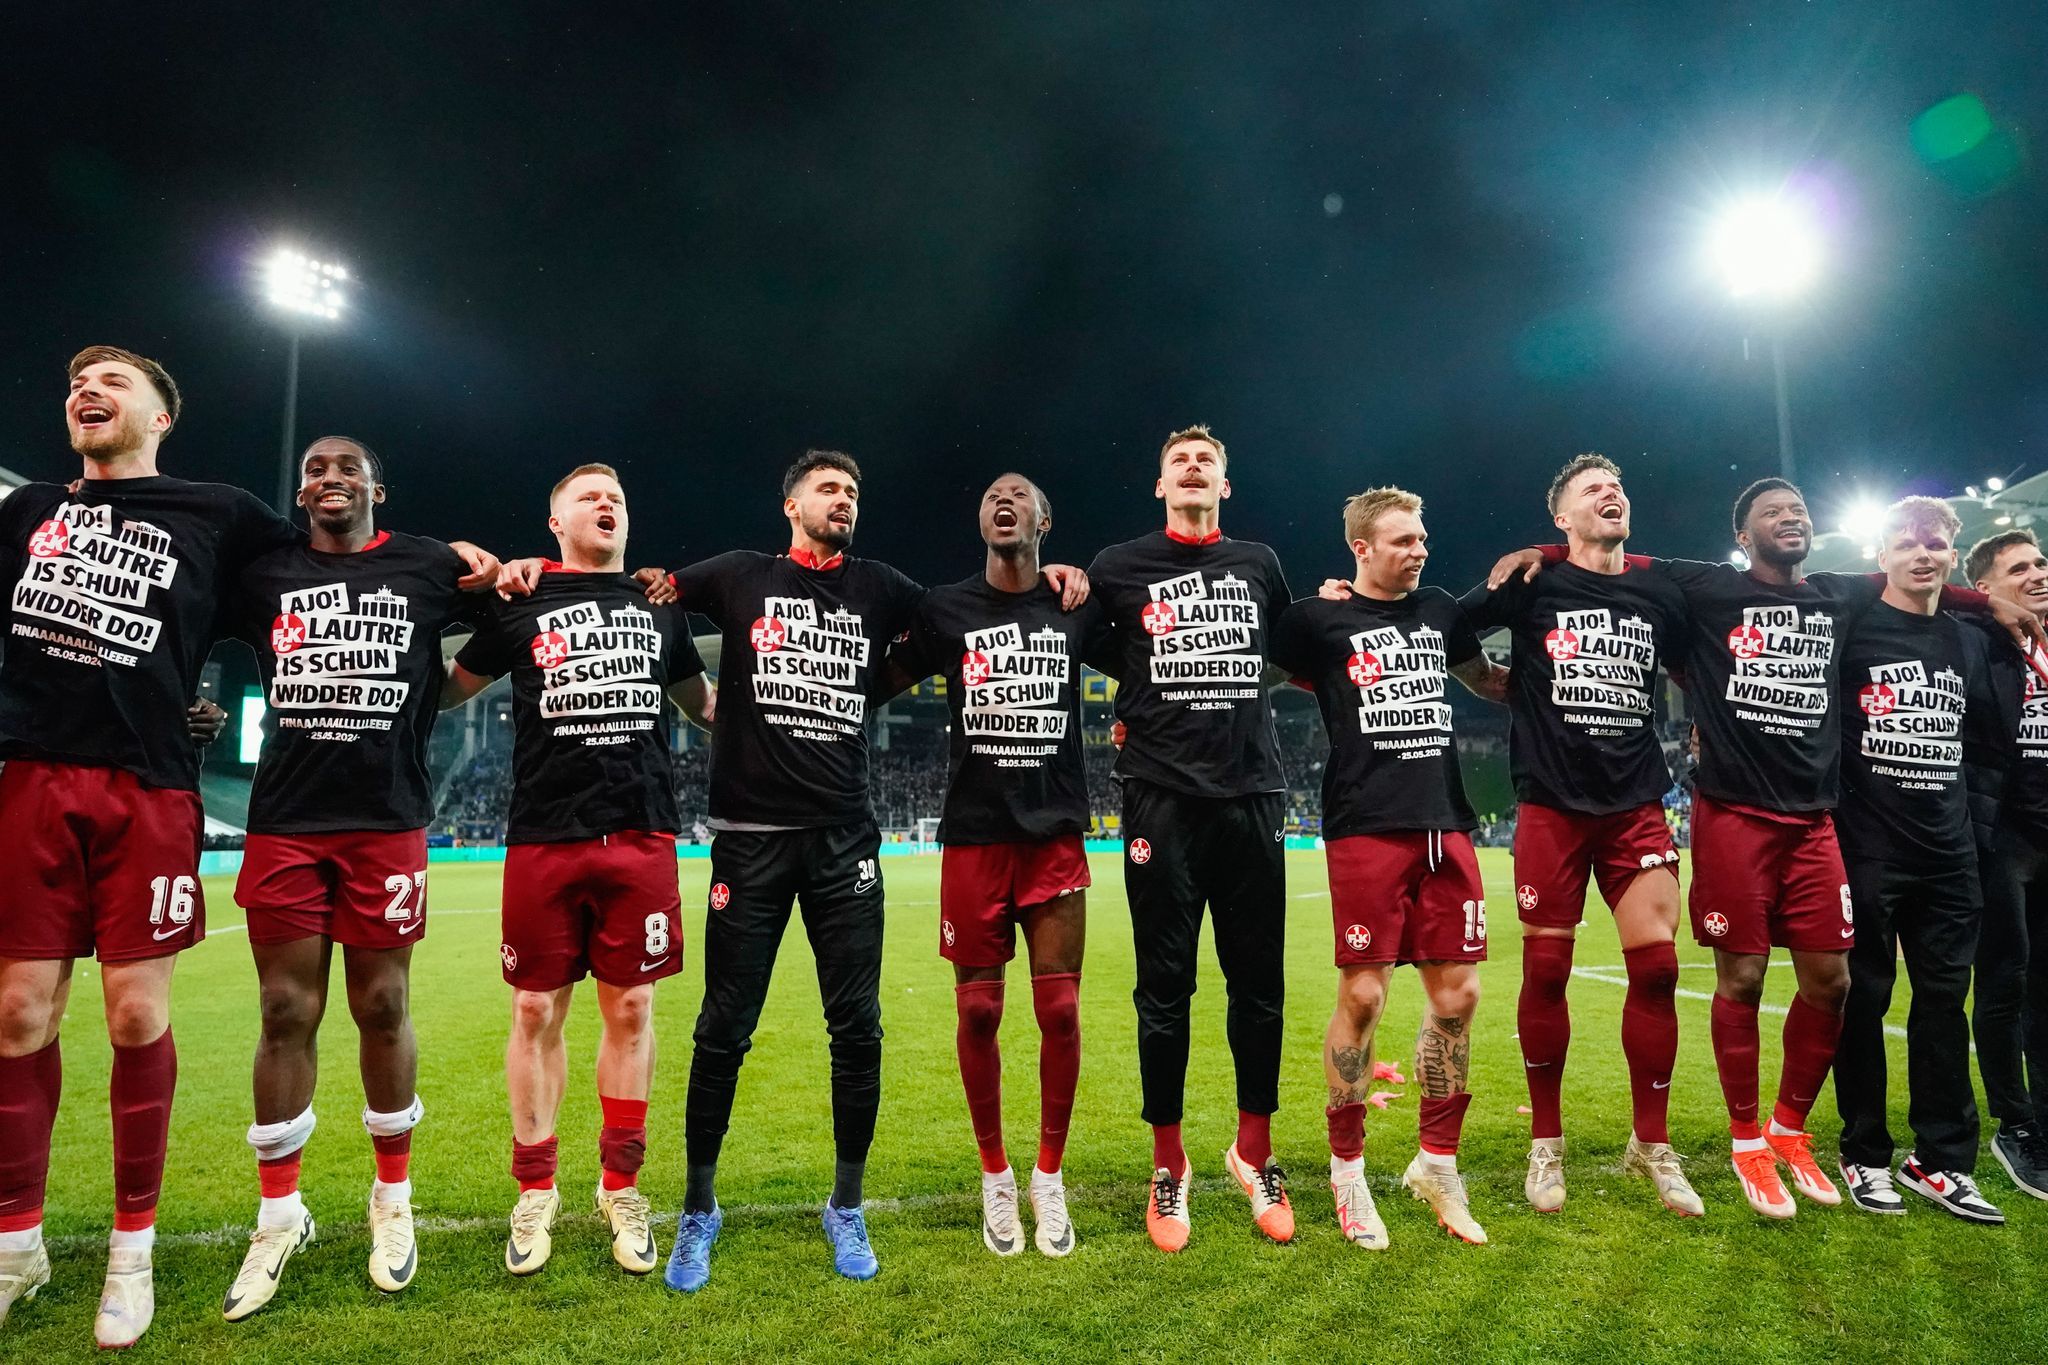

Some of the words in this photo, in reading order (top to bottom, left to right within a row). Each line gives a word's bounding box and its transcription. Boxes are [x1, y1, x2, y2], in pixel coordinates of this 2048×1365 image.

[62, 509, 104, 528] AJO!
[136, 524, 159, 534] BERLIN
[69, 534, 168, 582] LAUTRE
[32, 562, 57, 582] IS
[60, 565, 140, 600] SCHUN
[1159, 578, 1200, 601] AJO!
[290, 589, 341, 613] AJO!
[773, 602, 811, 620] AJO!
[16, 586, 103, 629] WIDDER
[105, 615, 153, 645] DO!
[549, 607, 595, 631] AJO!
[1178, 604, 1254, 624] LAUTRE
[1566, 613, 1605, 630] AJO!
[1752, 610, 1793, 628] AJO!
[309, 617, 407, 647] LAUTRE
[570, 631, 656, 654] LAUTRE
[787, 625, 864, 662] LAUTRE
[975, 629, 1016, 651] AJO!
[1159, 638, 1178, 655] IS
[1182, 627, 1244, 651] SCHUN
[1361, 631, 1399, 652] AJO!
[1580, 635, 1652, 666] LAUTRE
[1766, 633, 1830, 660] LAUTRE
[282, 656, 304, 677] IS
[308, 649, 390, 674] SCHUN
[550, 669, 570, 688] IS
[574, 655, 644, 682] SCHUN
[762, 656, 781, 675] IS
[786, 657, 850, 681] SCHUN
[992, 654, 1066, 678] LAUTRE
[1155, 661, 1230, 678] WIDDER
[1232, 661, 1261, 678] DO!
[1382, 653, 1446, 674] LAUTRE
[1559, 664, 1579, 680] IS
[1583, 664, 1640, 682] SCHUN
[1742, 663, 1760, 677] IS
[1764, 663, 1822, 679] SCHUN
[1881, 665, 1921, 684] AJO!
[275, 684, 364, 705] WIDDER
[367, 686, 403, 708] DO!
[546, 689, 628, 713] WIDDER
[632, 689, 659, 709] DO!
[756, 680, 832, 710] WIDDER
[835, 696, 861, 719] DO!
[971, 689, 989, 707] IS
[993, 681, 1054, 704] SCHUN
[1367, 687, 1386, 705] IS
[1389, 676, 1442, 700] SCHUN
[1557, 686, 1624, 707] WIDDER
[1733, 681, 1806, 709] WIDDER
[965, 713, 1039, 733] WIDDER
[1365, 708, 1436, 728] WIDDER
[1875, 719, 1896, 733] IS
[1899, 717, 1955, 734] SCHUN
[1868, 737, 1942, 760] WIDDER
[858, 859, 875, 880] 30
[149, 876, 196, 924] 16
[385, 870, 427, 921] 27
[1463, 900, 1486, 940] 15
[645, 912, 669, 956] 8
